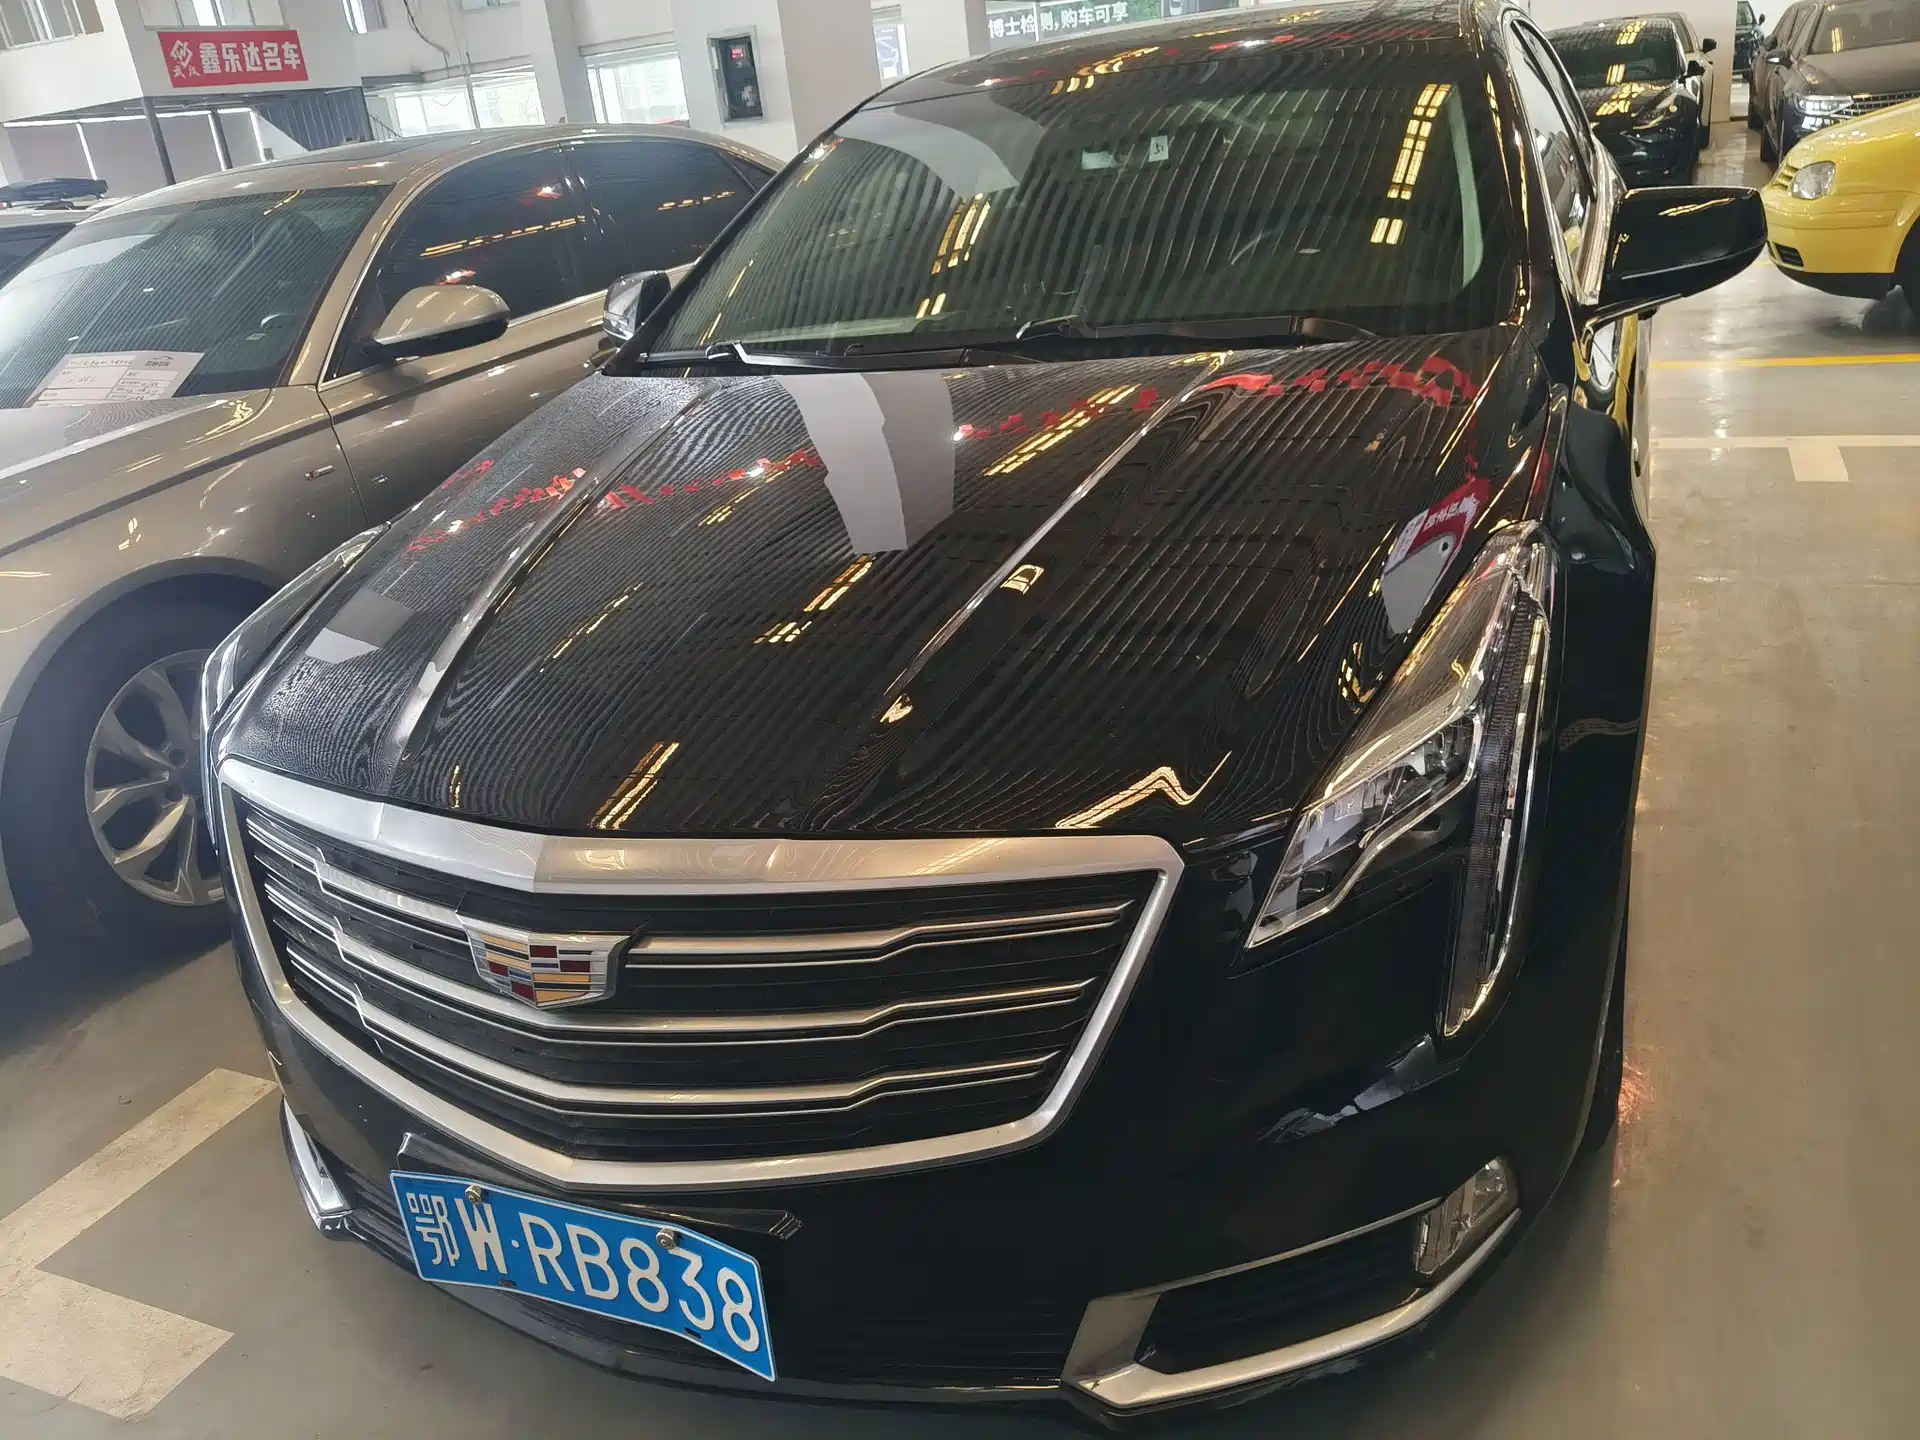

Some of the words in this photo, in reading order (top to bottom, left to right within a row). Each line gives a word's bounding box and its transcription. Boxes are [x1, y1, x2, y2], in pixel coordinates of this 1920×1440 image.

[199, 41, 301, 74] 鑫乐达名车
[405, 1192, 760, 1353] 鄂W·RB838
